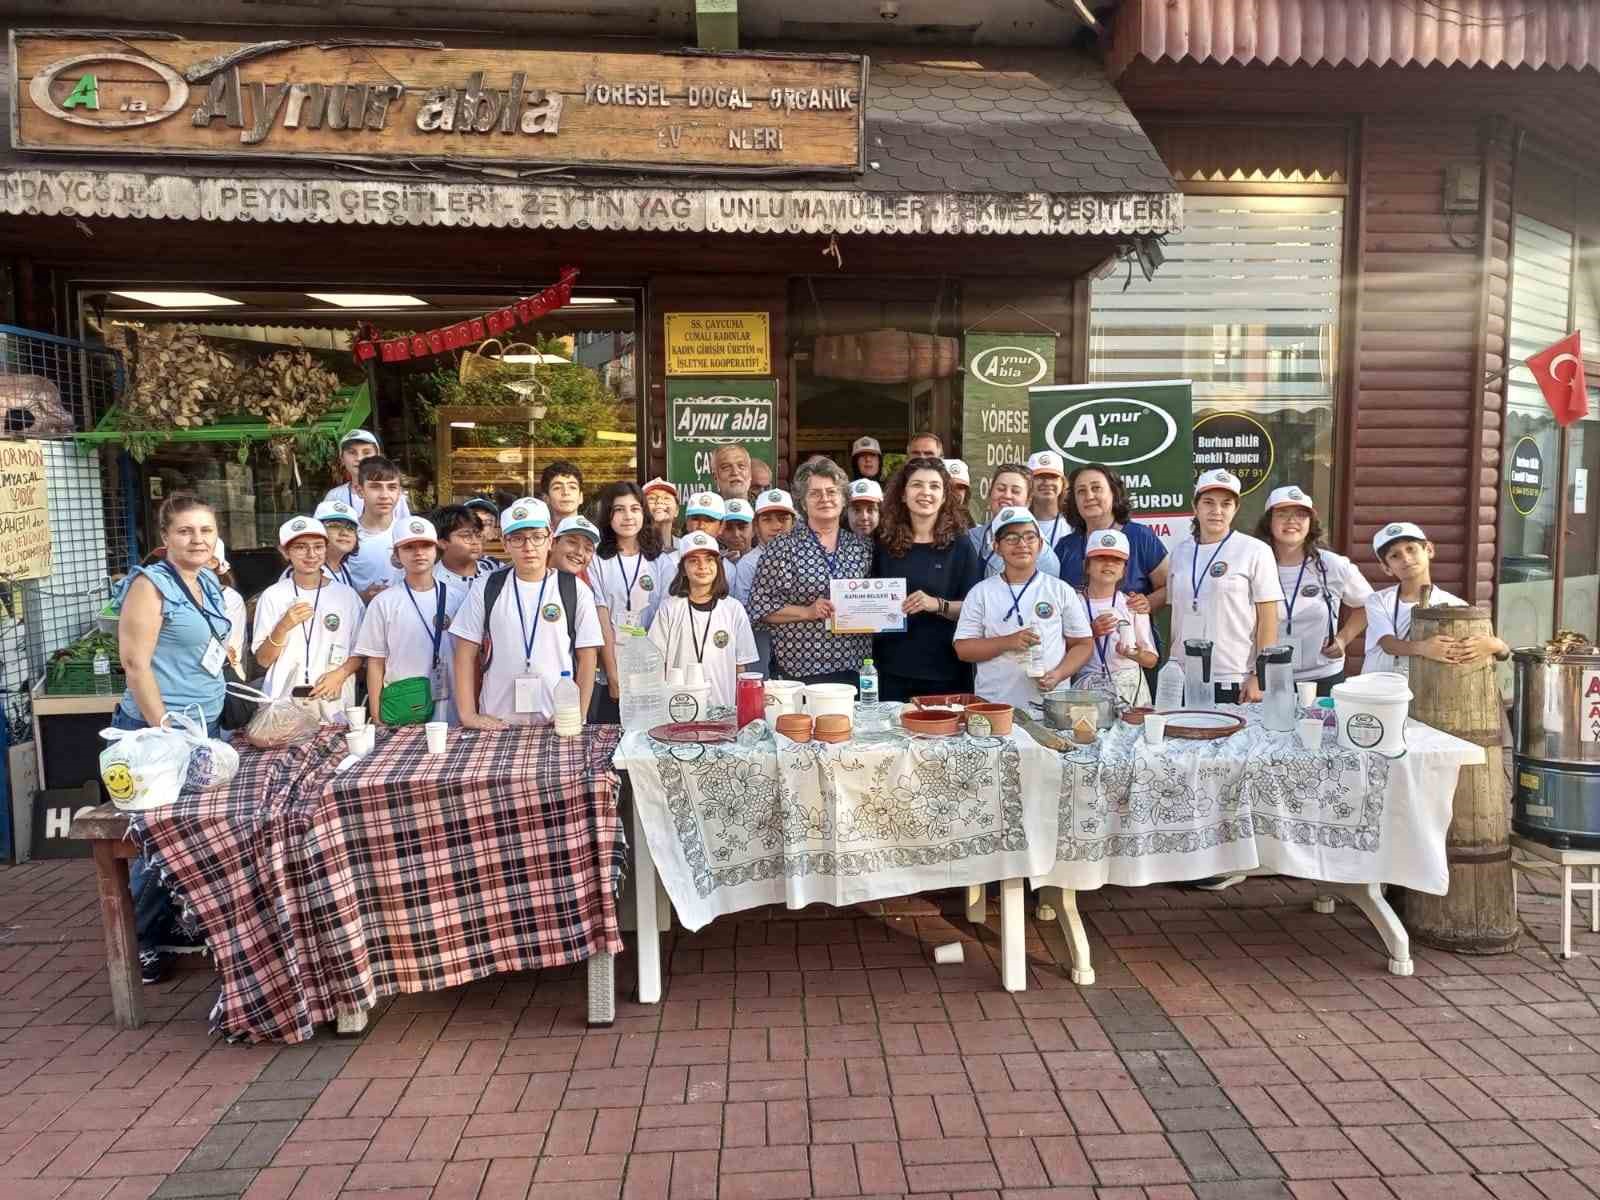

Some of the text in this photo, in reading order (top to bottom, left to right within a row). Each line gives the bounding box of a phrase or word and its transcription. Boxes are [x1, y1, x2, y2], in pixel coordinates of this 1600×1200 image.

[192, 66, 563, 144] Aynur abla
[221, 183, 330, 209] PEYNİR
[678, 407, 768, 436] Aynur abla
[981, 403, 1031, 433] YÖRESE
[1198, 434, 1260, 448] Burhan BİLİR
[1224, 452, 1260, 464] Tapucu
